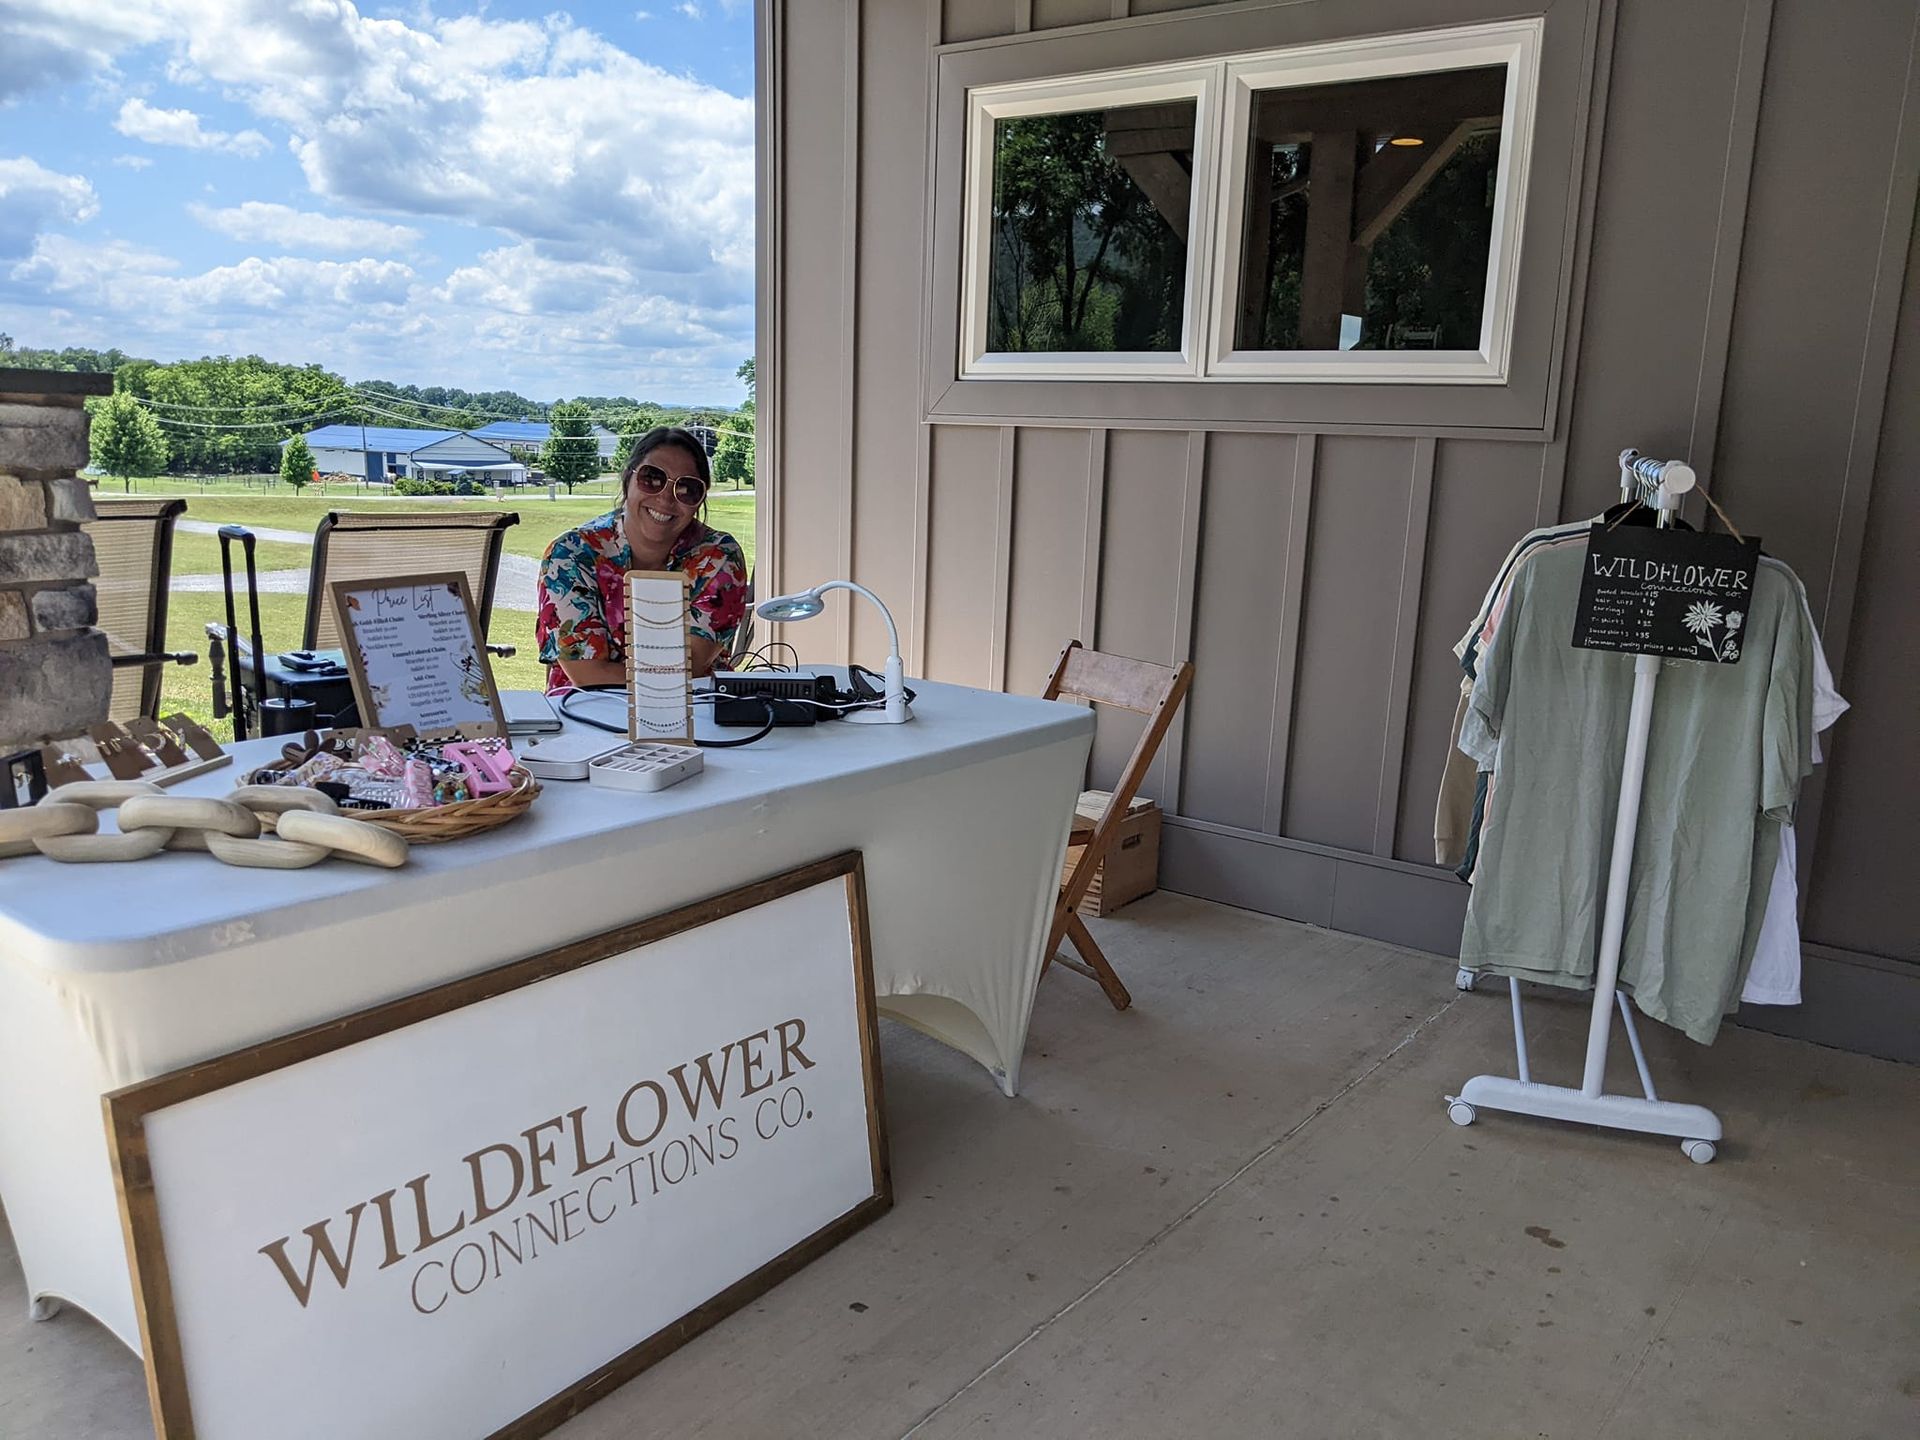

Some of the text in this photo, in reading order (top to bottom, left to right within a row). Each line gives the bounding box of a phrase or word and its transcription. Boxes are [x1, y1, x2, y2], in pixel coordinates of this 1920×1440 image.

[371, 585, 441, 617] Price List
[1592, 553, 1749, 590] WILDFLOWER
[258, 1017, 817, 1308] WILDFLOWER
[411, 1086, 814, 1314] CONNECTIONS CO.
